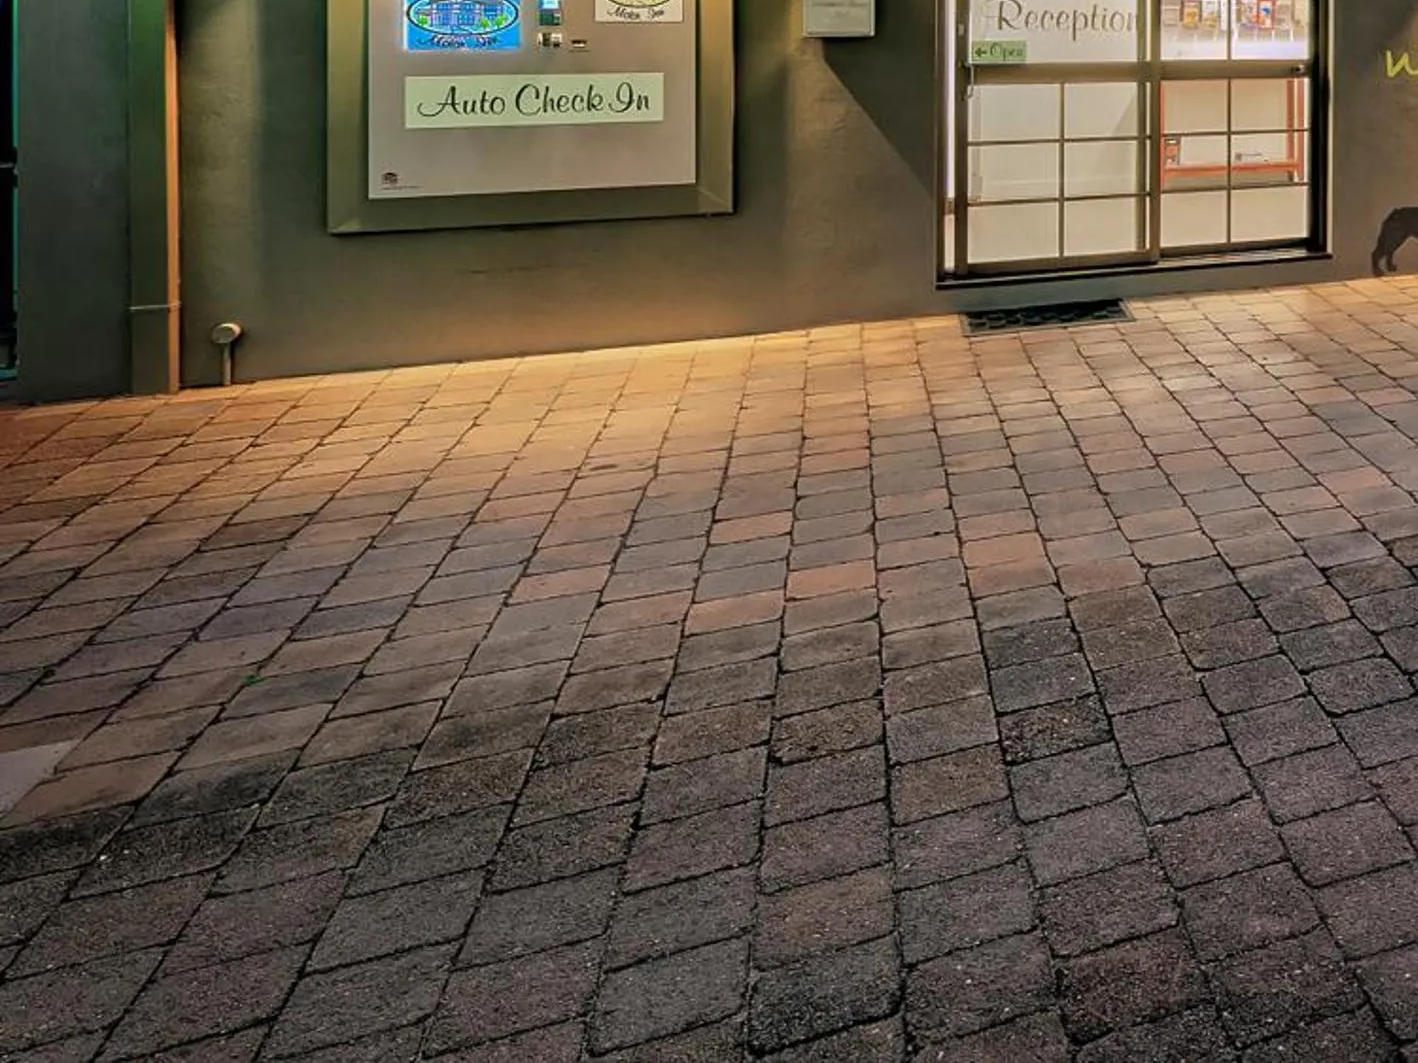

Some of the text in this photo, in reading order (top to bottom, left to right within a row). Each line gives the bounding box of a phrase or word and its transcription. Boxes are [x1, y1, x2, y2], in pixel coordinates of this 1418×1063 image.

[990, 42, 1024, 61] Open
[417, 81, 650, 117] Auto Check In
